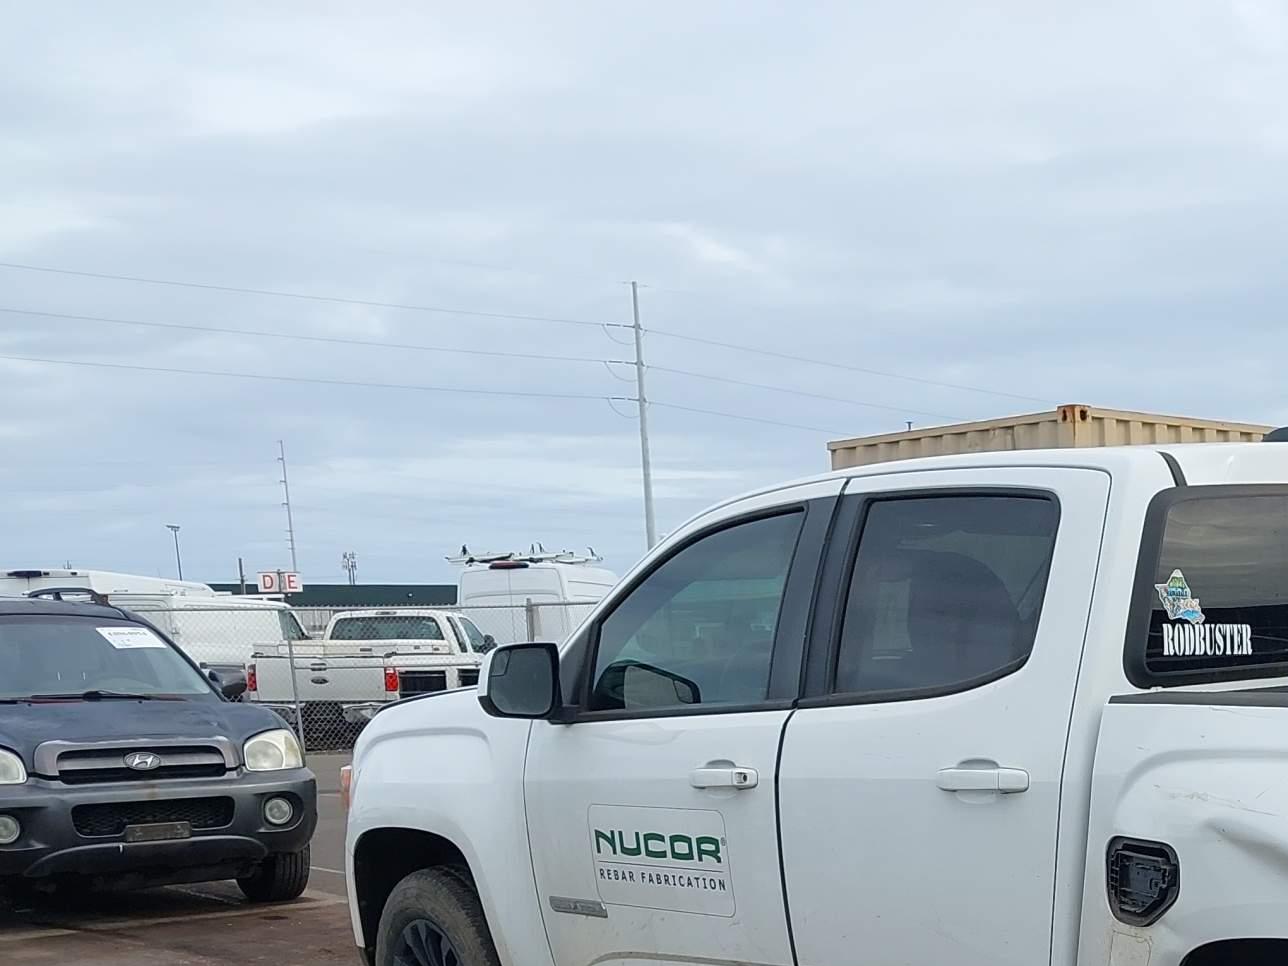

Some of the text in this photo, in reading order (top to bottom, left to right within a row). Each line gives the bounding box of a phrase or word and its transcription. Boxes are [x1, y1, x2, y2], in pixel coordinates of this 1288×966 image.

[262, 574, 274, 590] D
[287, 574, 298, 590] E
[1162, 623, 1253, 656] RODBUSTER
[594, 829, 722, 863] NUCOR
[599, 868, 726, 891] REBAR FABRICATION
